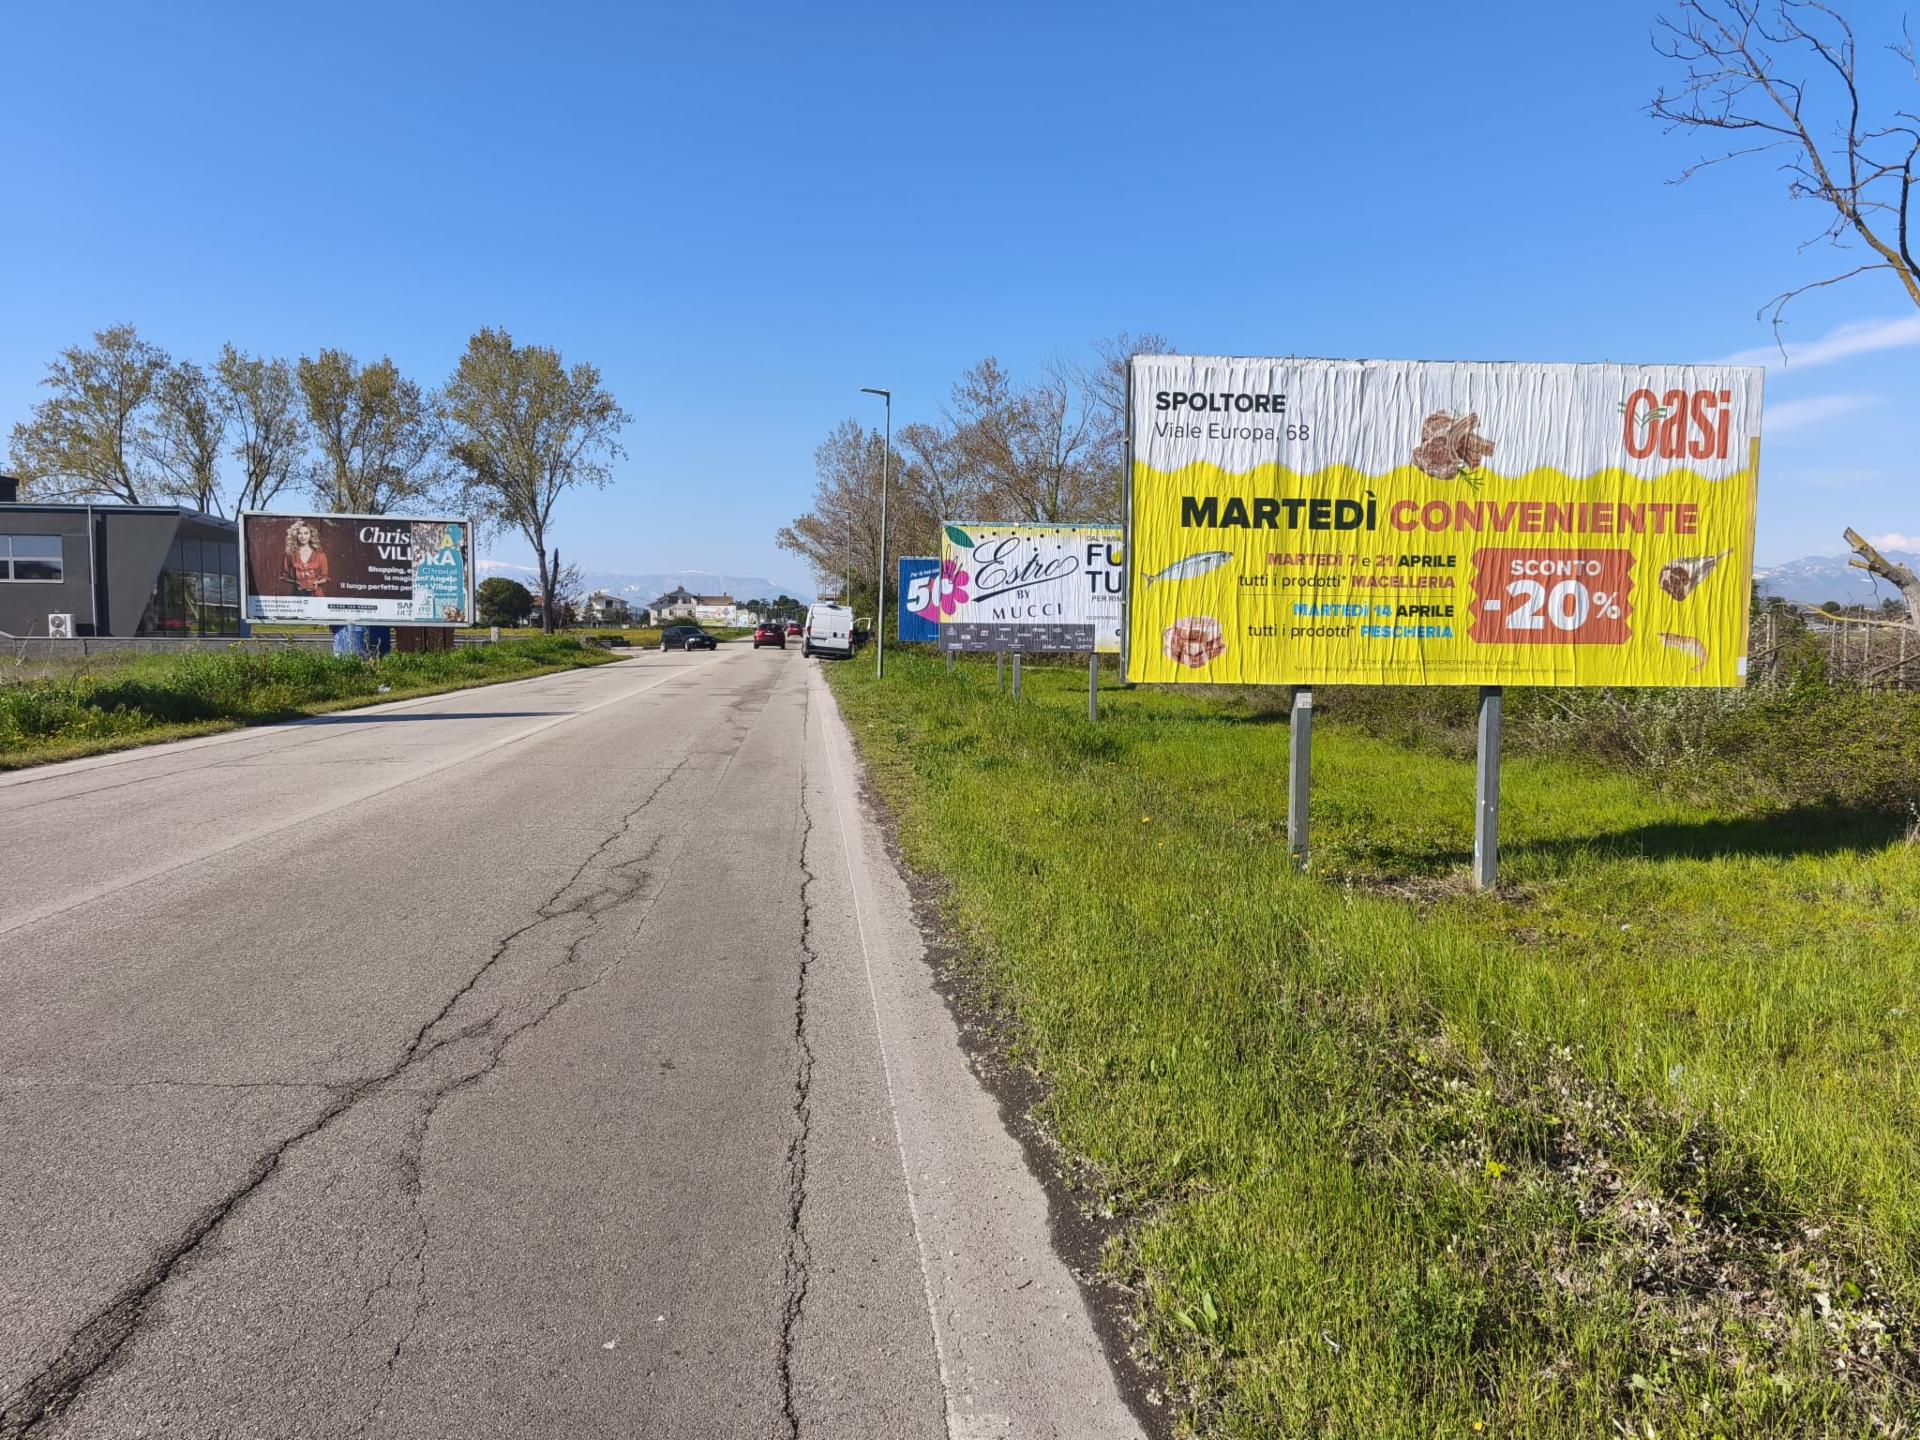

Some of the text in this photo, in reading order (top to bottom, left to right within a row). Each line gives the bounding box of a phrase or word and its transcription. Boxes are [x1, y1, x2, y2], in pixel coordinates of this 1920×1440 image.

[1156, 391, 1286, 413] SPOLTORE
[1155, 421, 1310, 443] Viale Europa, 68
[1181, 490, 1698, 535] MARTEDÌ CONVENIENTE
[973, 537, 1078, 589] Estro
[1267, 551, 1456, 568] MARTEDÌ 7 e 21 APRILE
[1511, 559, 1602, 576] SCONTO
[346, 582, 367, 590] luogo
[368, 583, 399, 591] perfetto
[1238, 574, 1268, 587] tutti
[1273, 574, 1277, 587] i
[1351, 575, 1456, 589] MACELLERIA
[1017, 590, 1031, 599] BY
[992, 602, 1062, 620] MUCCI
[1292, 601, 1454, 618] MARTEDÌ 14 APRILE
[1484, 579, 1621, 631] -20%
[1247, 624, 1277, 637] tutti
[1282, 624, 1286, 637] i
[1360, 624, 1454, 639] PESCHERIA
